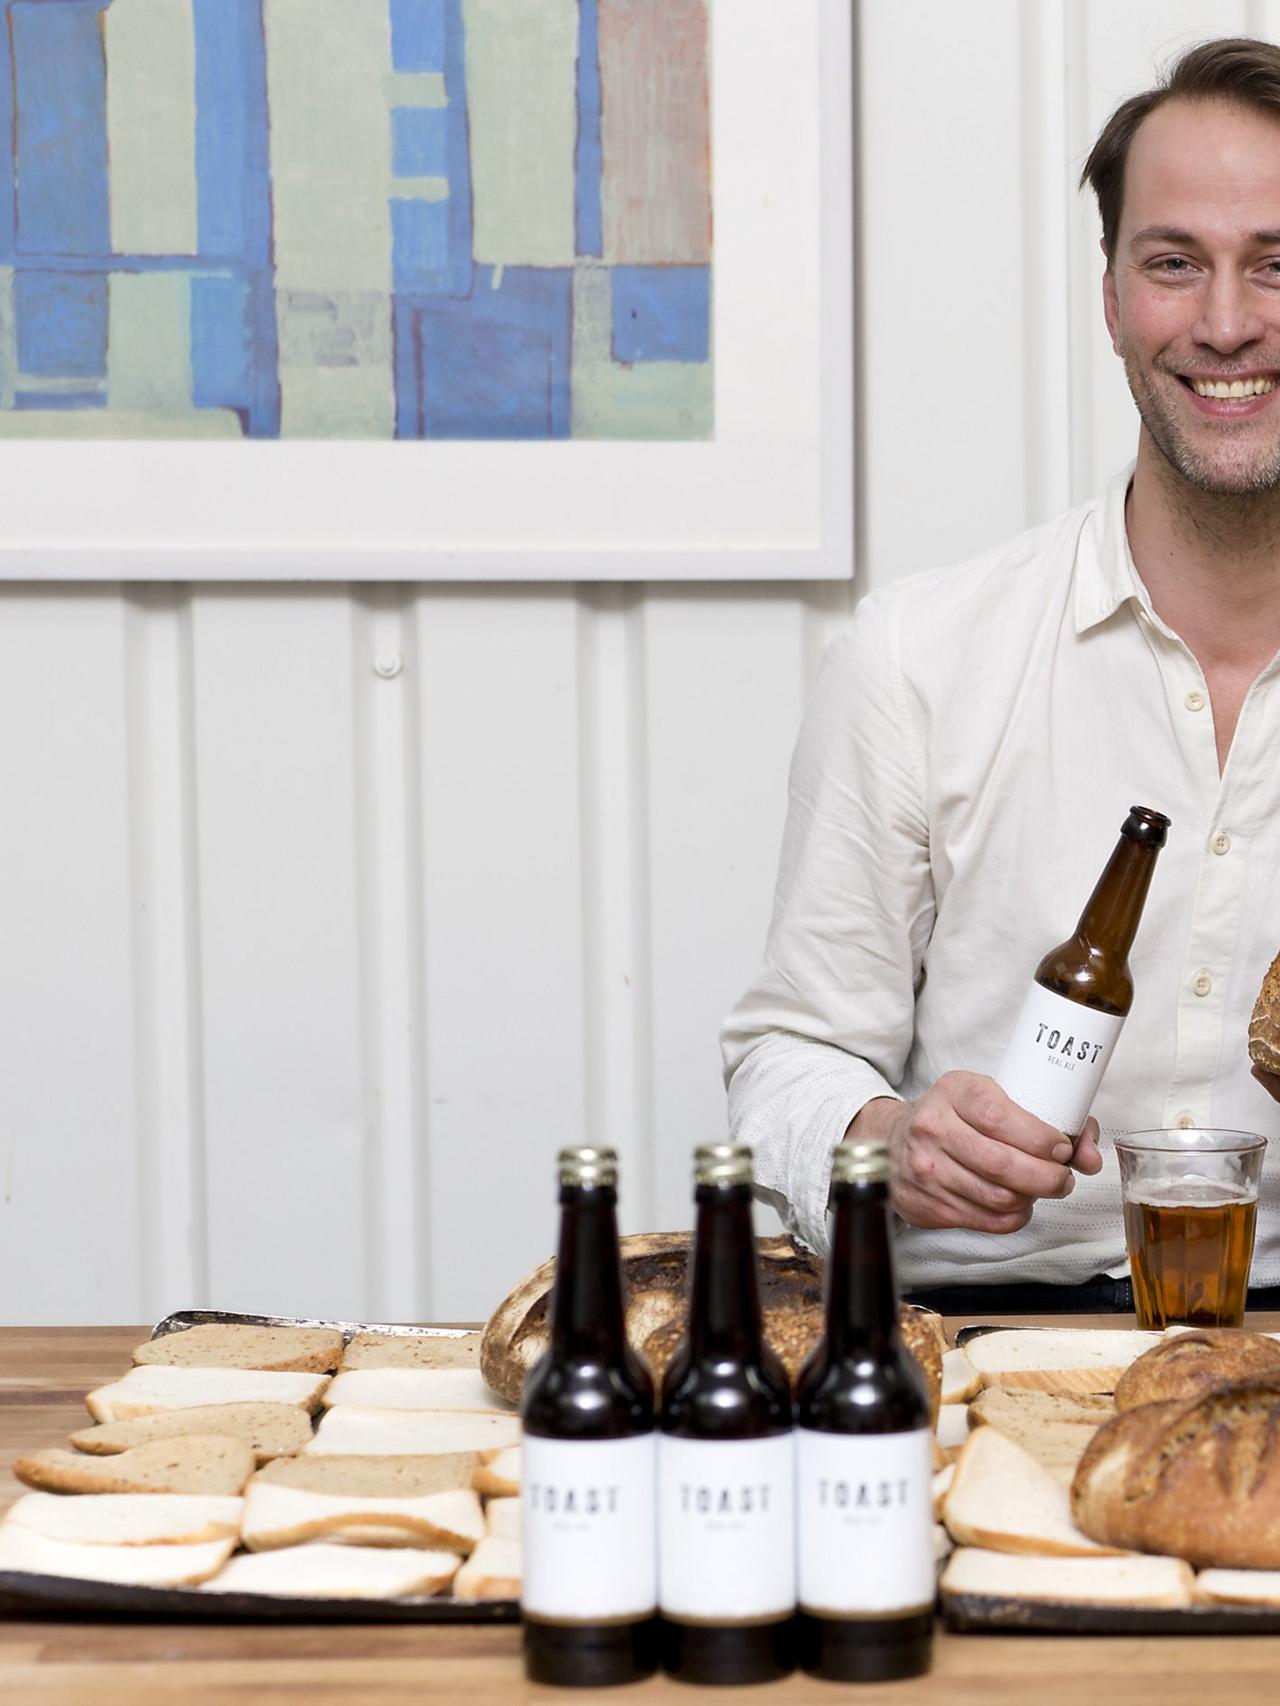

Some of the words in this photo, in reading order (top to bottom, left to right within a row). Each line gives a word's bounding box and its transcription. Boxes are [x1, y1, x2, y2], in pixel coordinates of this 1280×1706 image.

[1035, 1023, 1103, 1064] TOAST
[1047, 1055, 1063, 1068] REAL
[1064, 1061, 1076, 1072] ALE
[530, 1483, 620, 1514] TOAST
[680, 1483, 771, 1514] TOAST
[818, 1477, 910, 1509] TOAST
